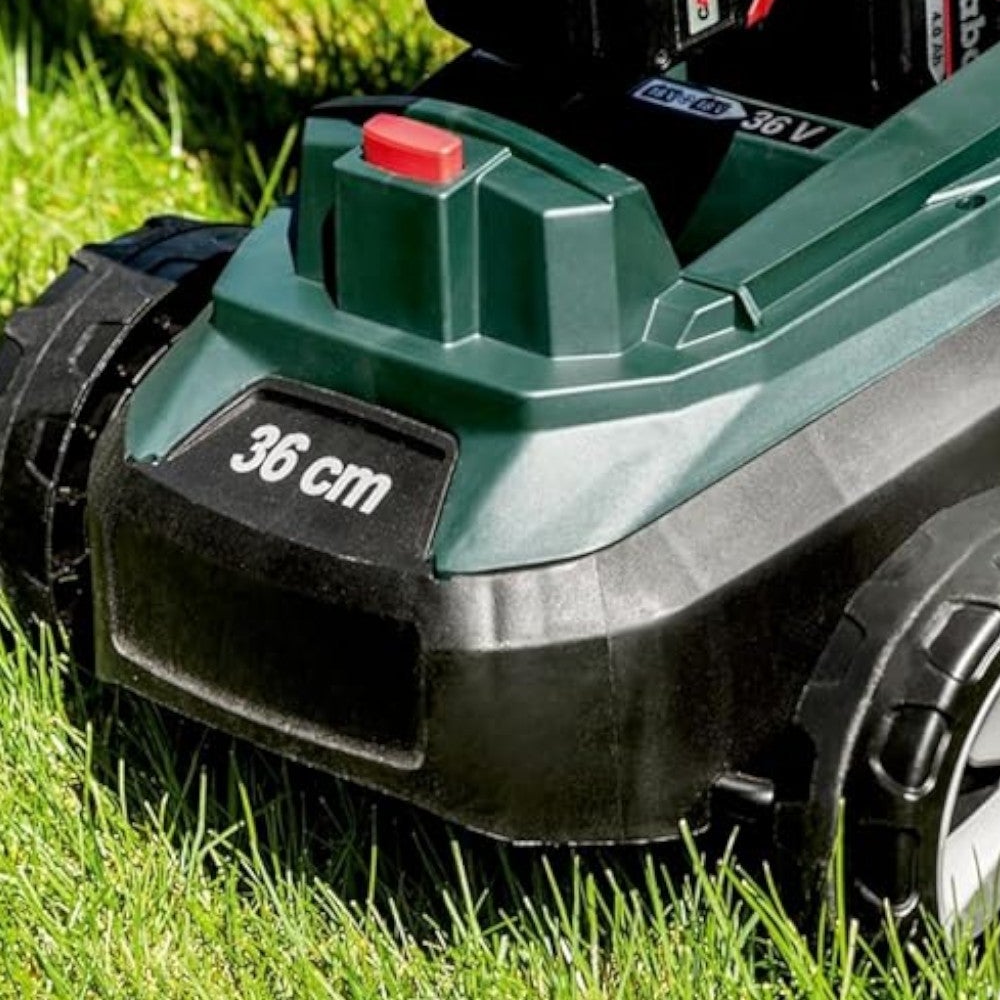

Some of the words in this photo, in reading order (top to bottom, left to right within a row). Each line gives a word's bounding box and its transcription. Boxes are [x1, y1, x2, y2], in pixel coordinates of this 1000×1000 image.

[740, 110, 792, 135] 36
[788, 121, 827, 144] V
[229, 423, 312, 482] 36
[299, 455, 393, 515] cm
